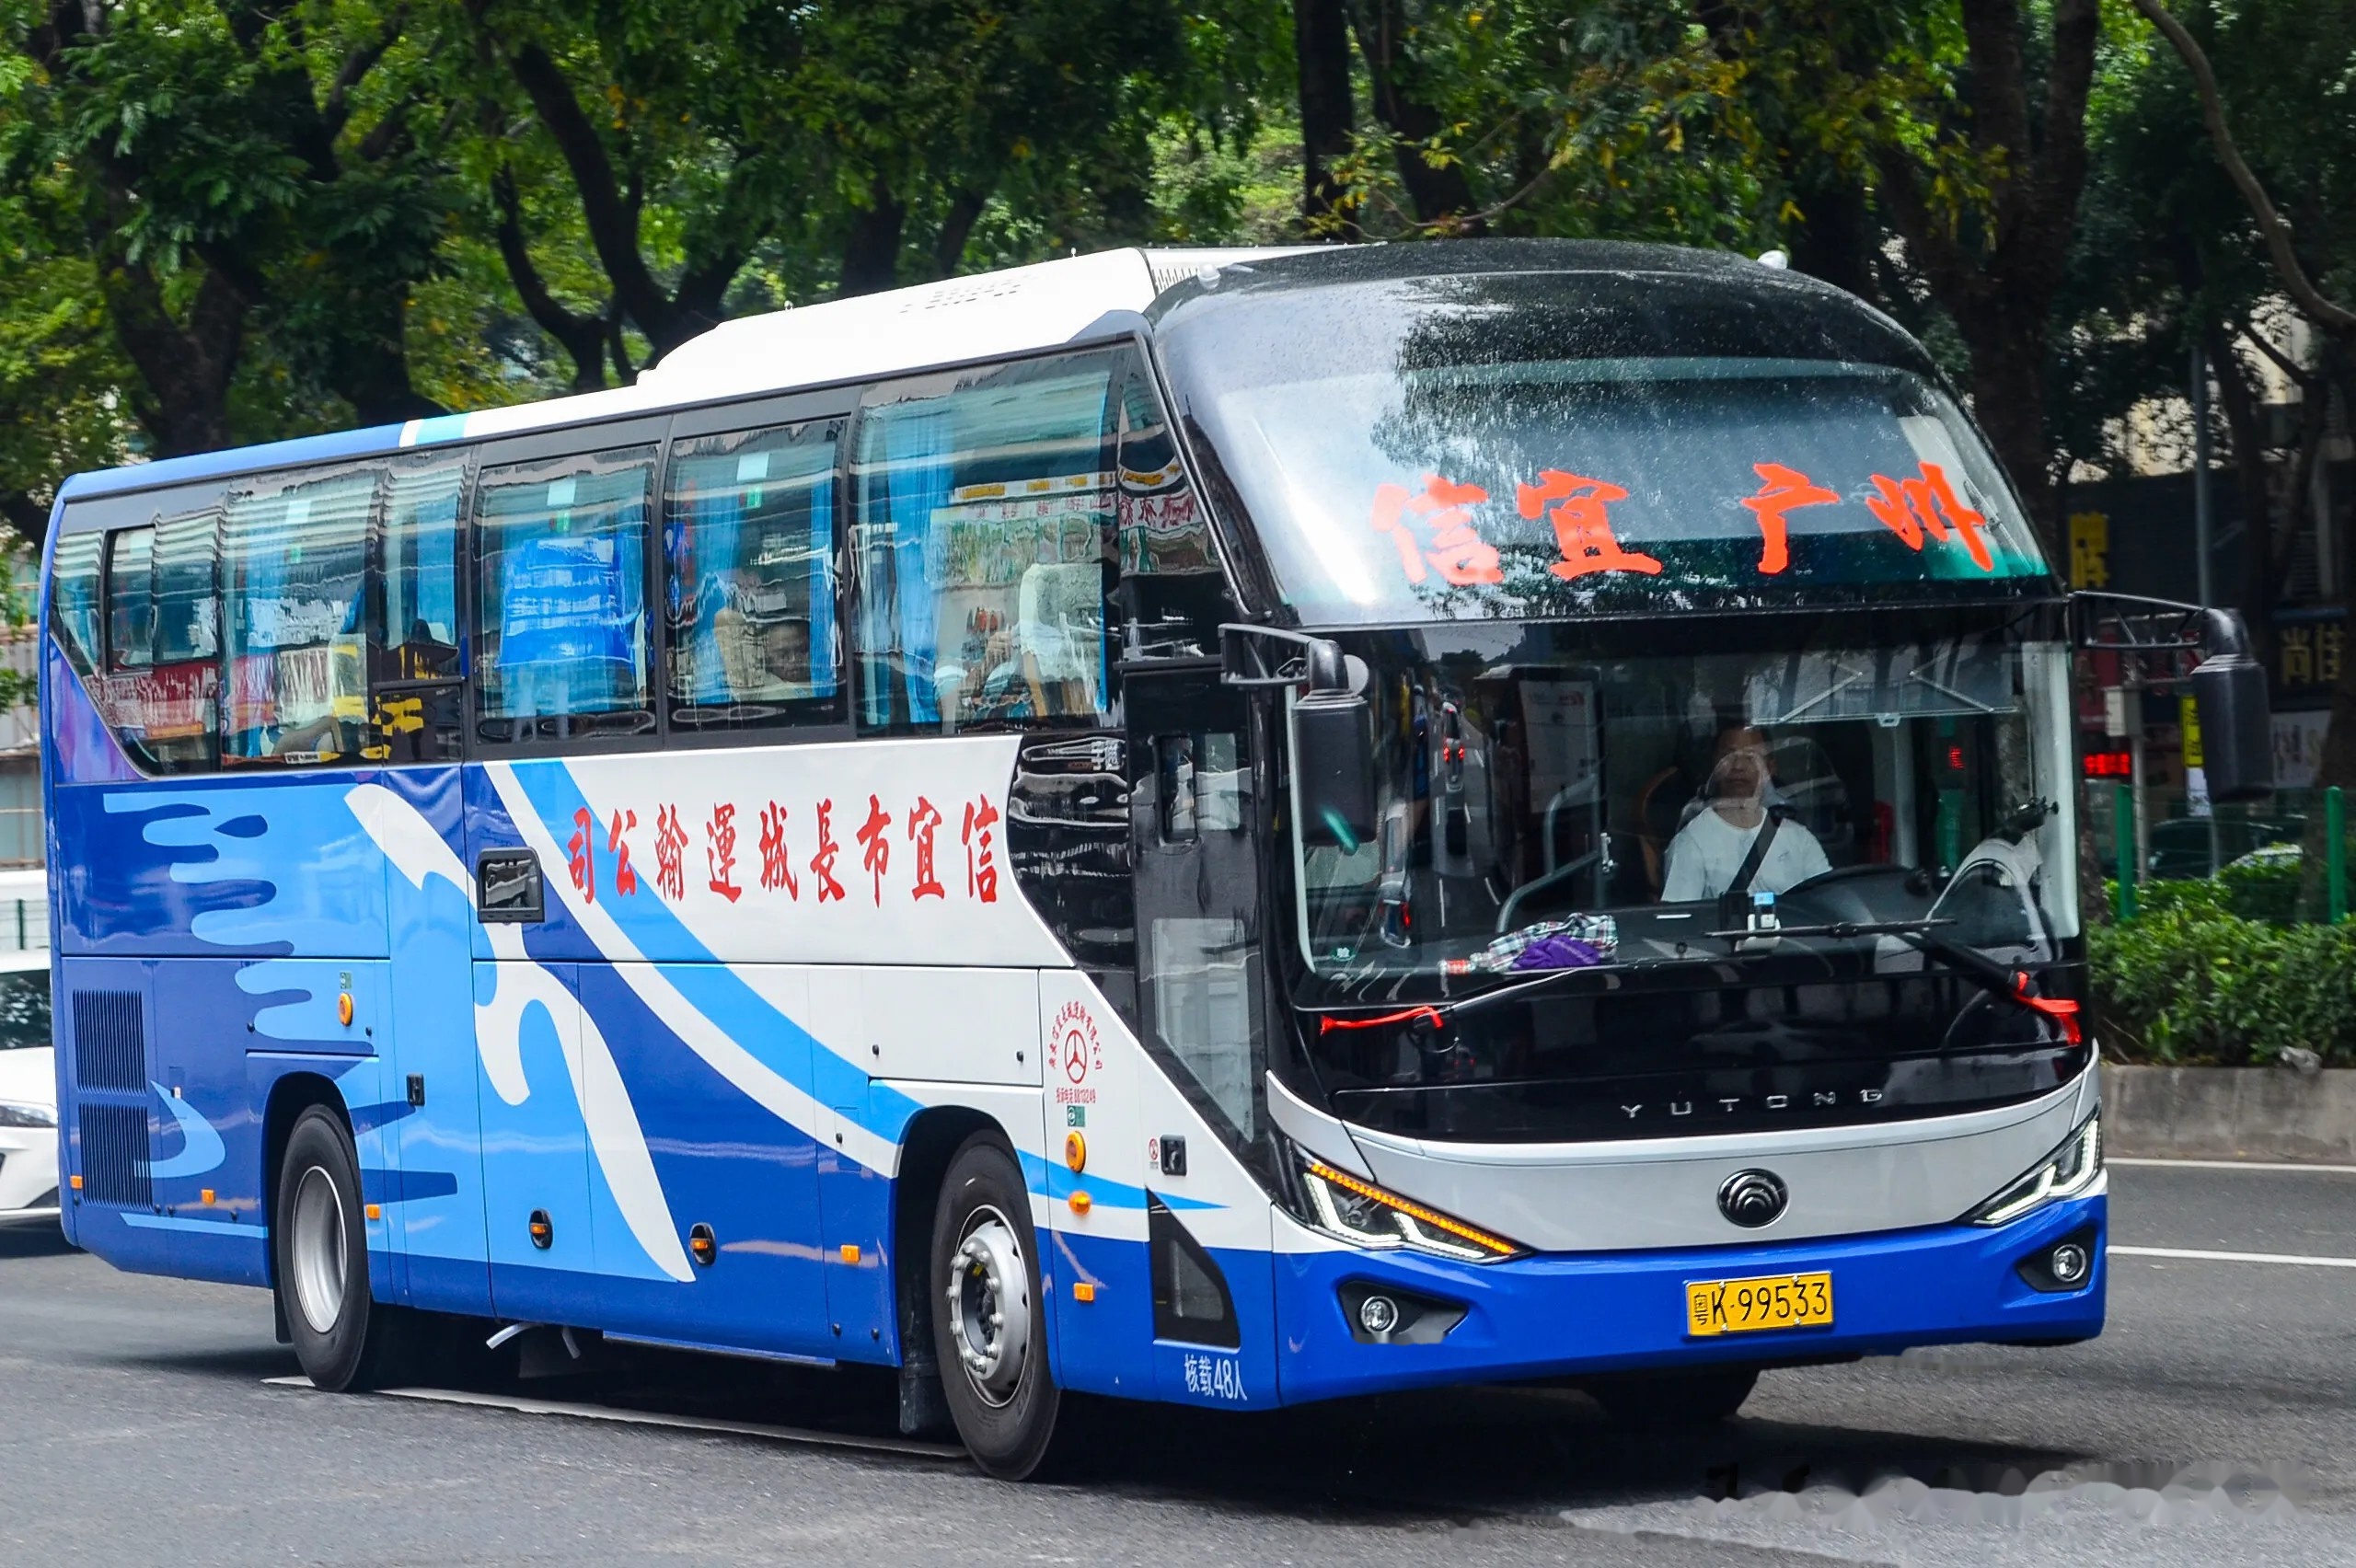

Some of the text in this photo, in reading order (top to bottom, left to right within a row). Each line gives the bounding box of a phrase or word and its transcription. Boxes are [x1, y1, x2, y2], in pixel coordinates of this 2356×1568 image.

[1369, 470, 1663, 586] 信宜
[1739, 460, 1994, 575] 广州
[1620, 1089, 1883, 1119] YUTONG
[1184, 1353, 1248, 1401] 核载48人
